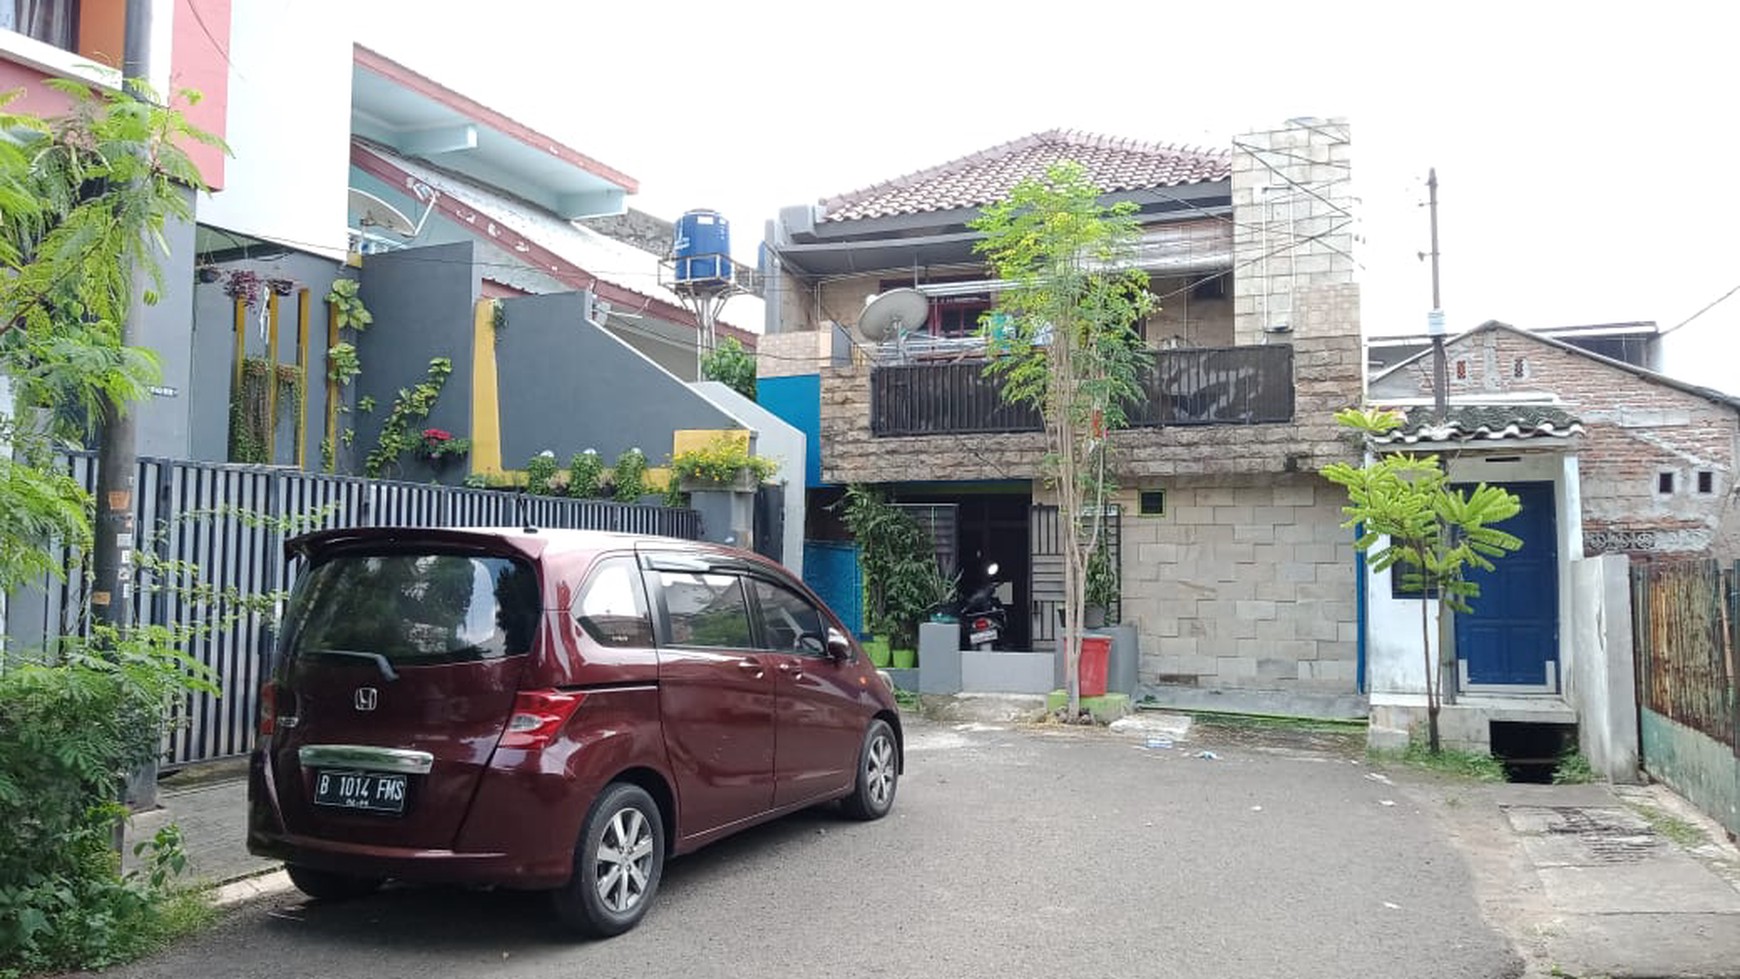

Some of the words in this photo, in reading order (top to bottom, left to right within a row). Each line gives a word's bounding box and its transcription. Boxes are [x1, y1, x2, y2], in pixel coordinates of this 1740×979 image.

[320, 774, 330, 795] B
[340, 776, 371, 798] 1014
[376, 779, 404, 801] FMS
